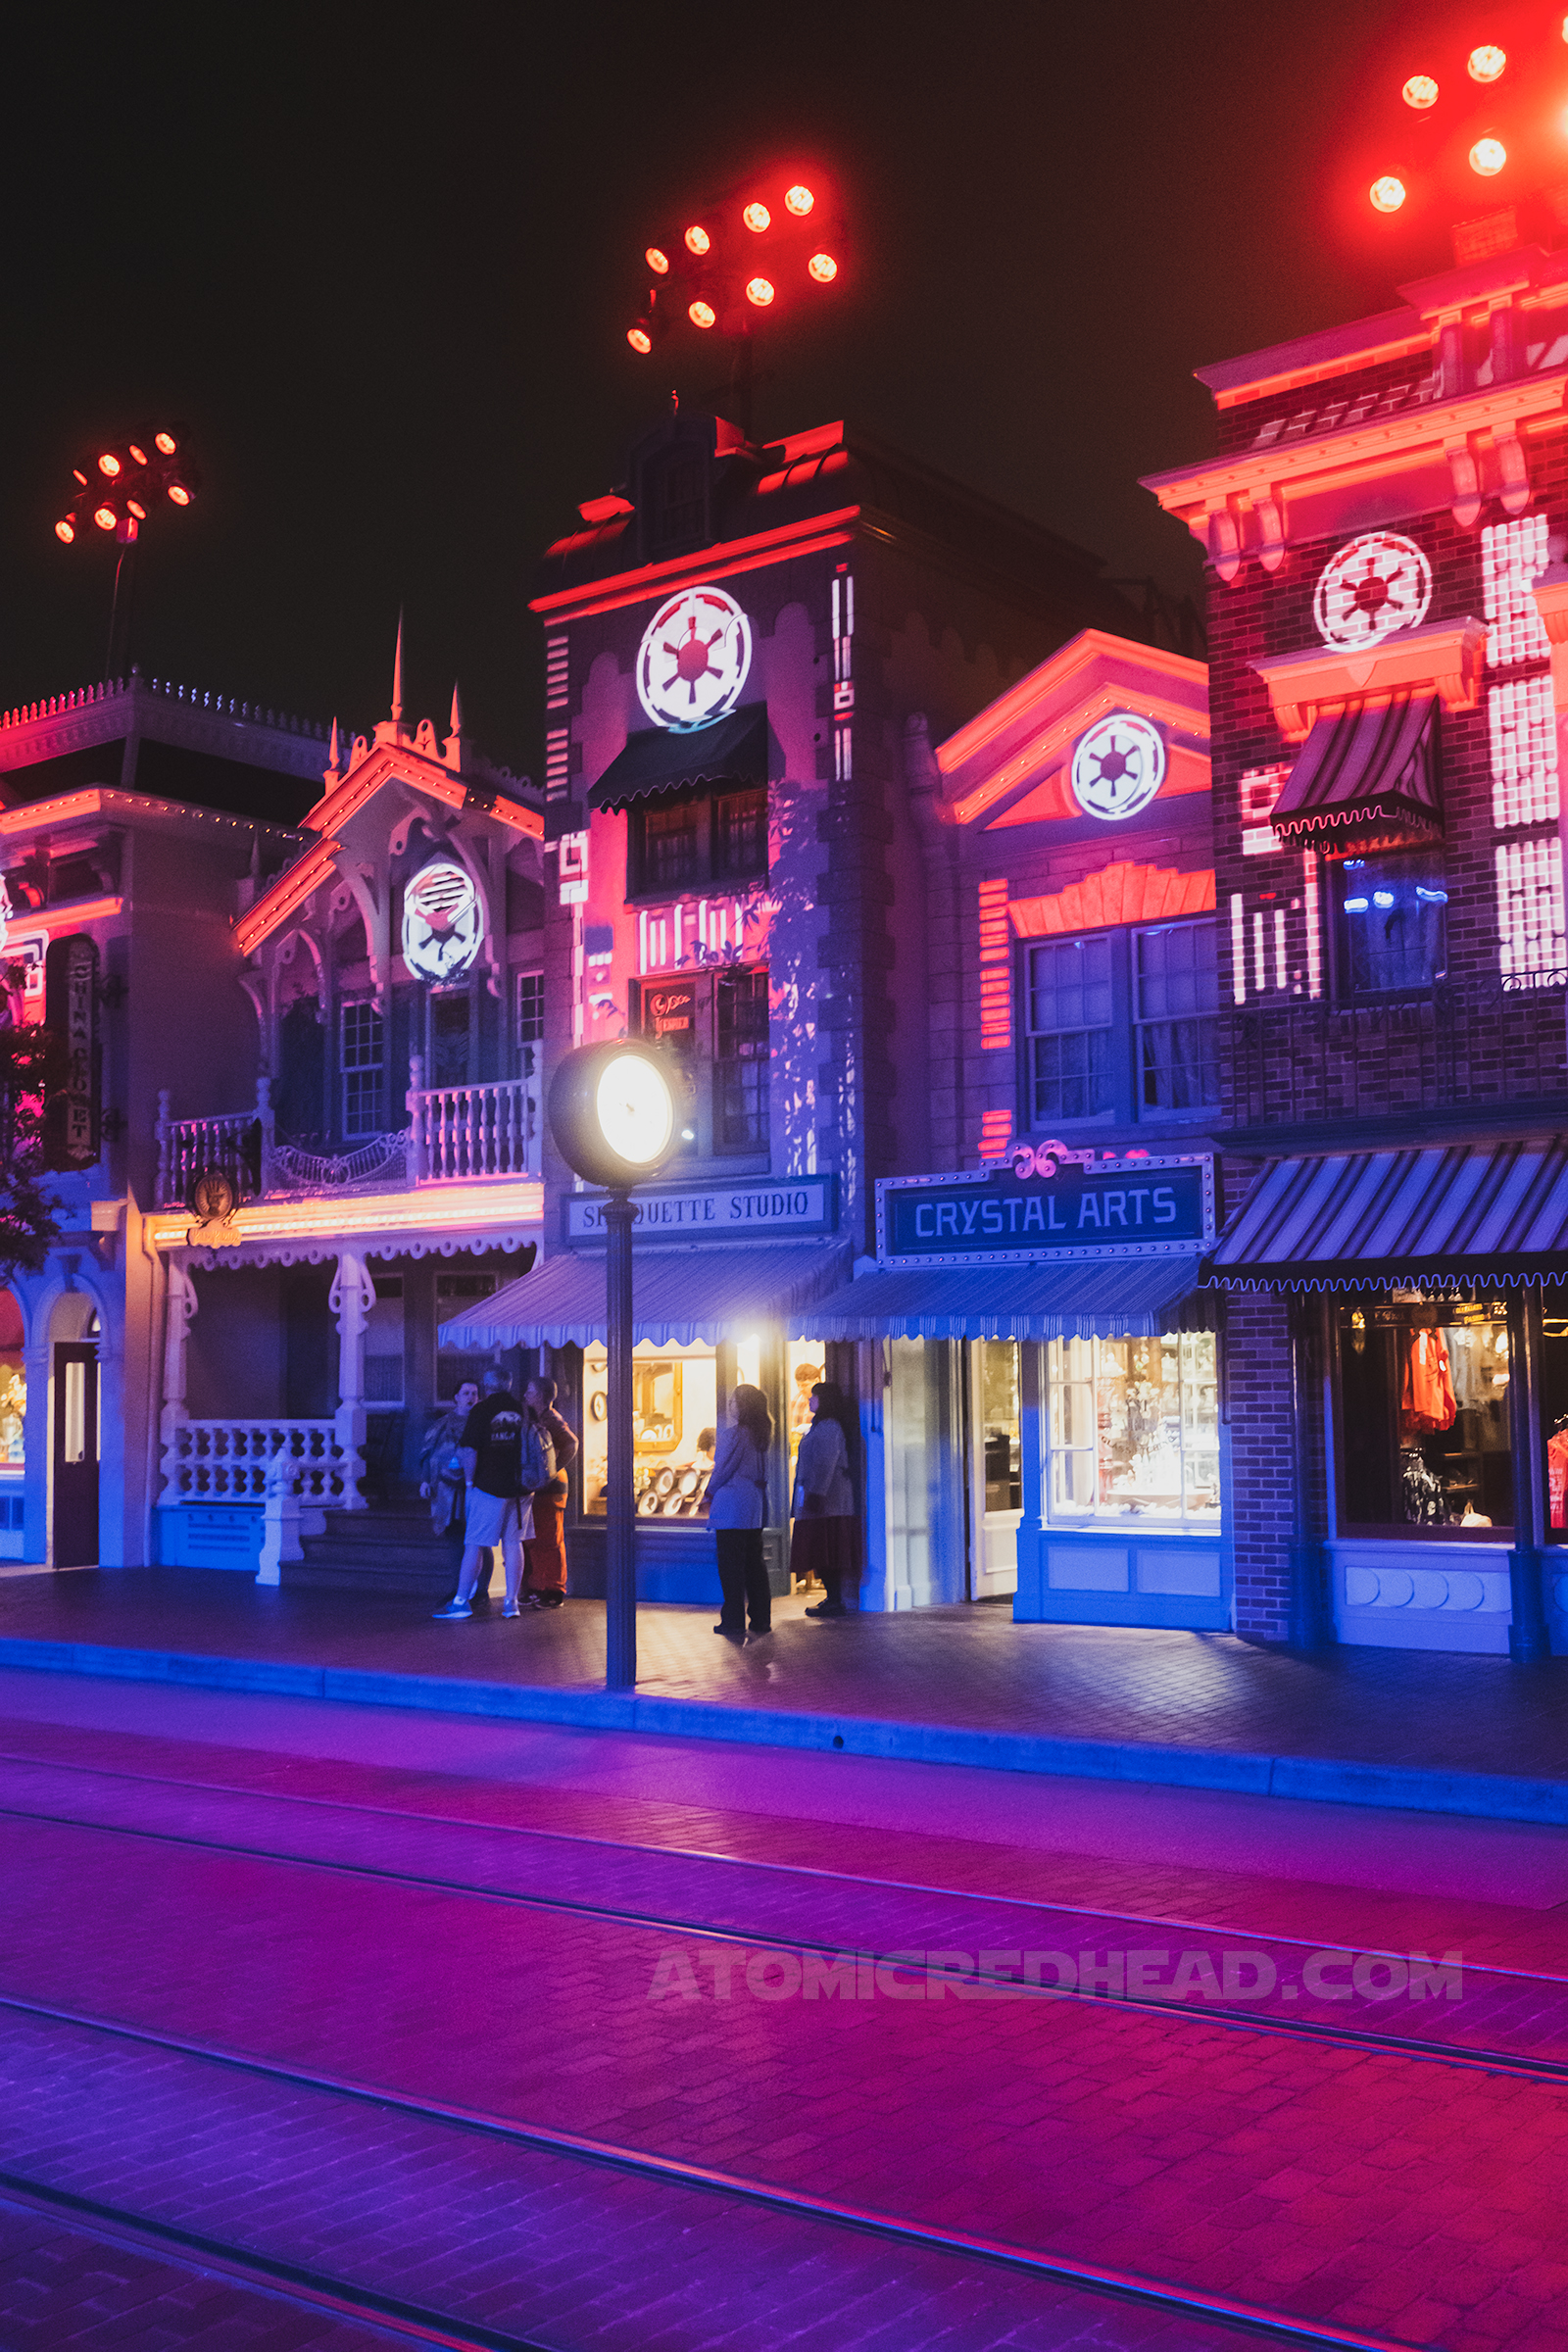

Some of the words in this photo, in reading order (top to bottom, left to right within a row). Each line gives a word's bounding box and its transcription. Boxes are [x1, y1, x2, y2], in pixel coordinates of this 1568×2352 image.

[582, 1198, 716, 1228] SIOUETTE
[729, 1191, 809, 1219] STUDIO
[914, 1196, 1066, 1237] CRYSTAL
[1077, 1187, 1177, 1229] ARTS
